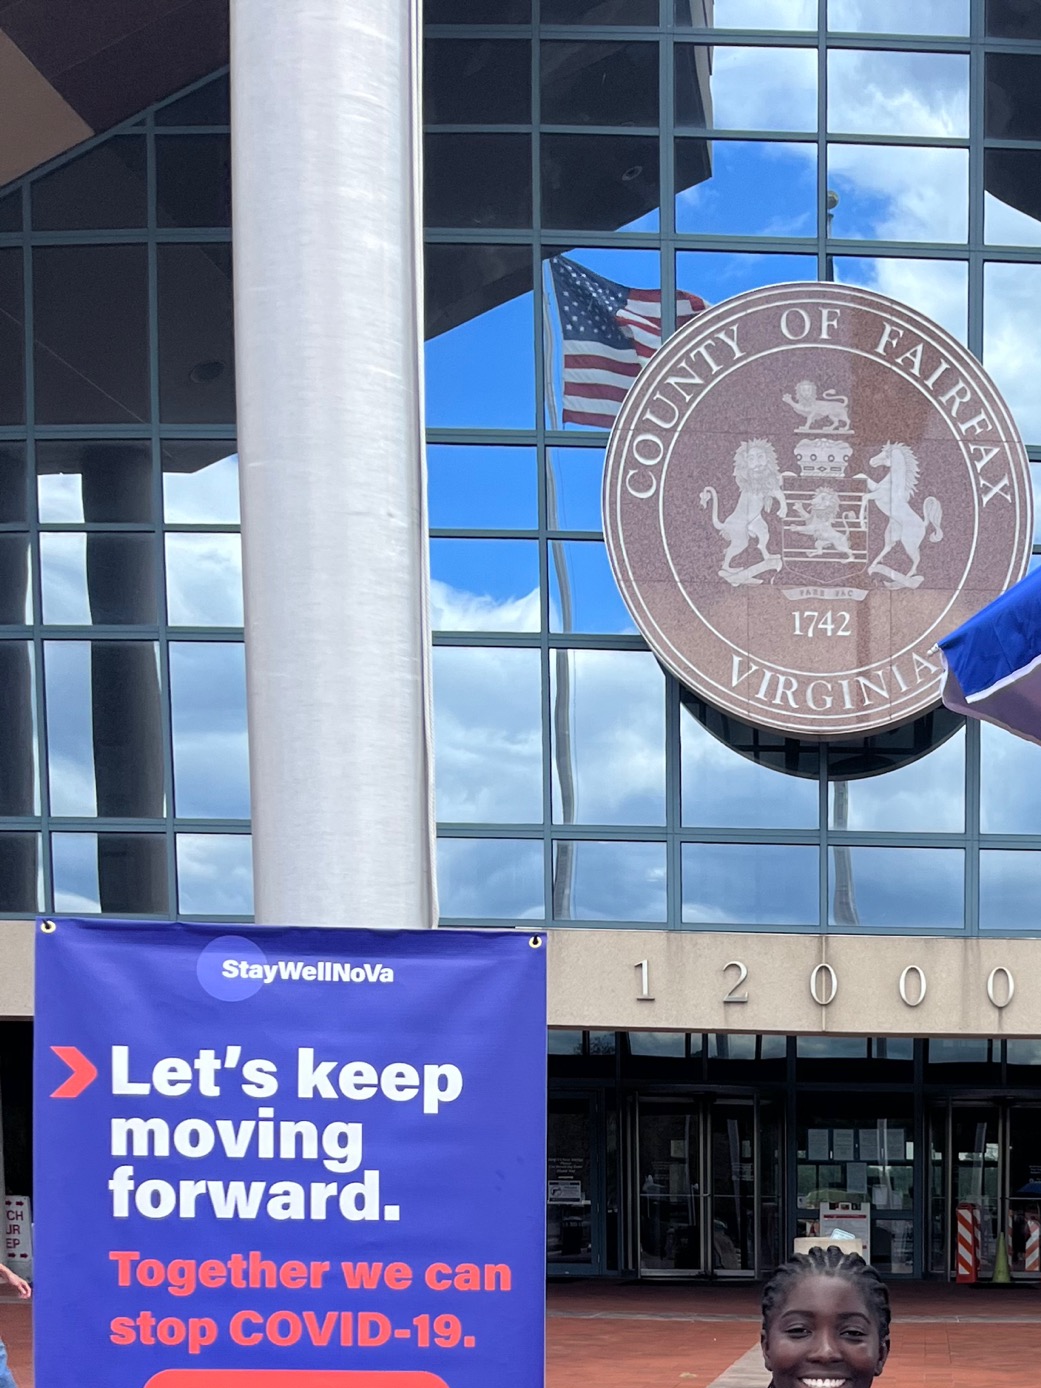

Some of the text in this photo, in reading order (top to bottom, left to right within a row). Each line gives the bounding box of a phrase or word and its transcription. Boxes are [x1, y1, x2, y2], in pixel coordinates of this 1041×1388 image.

[626, 307, 1013, 508] COUNTY OF FAIRFAX
[791, 610, 852, 637] 1742
[730, 650, 940, 711] VIRGINIA
[222, 959, 395, 983] StayWellNoVa
[111, 1045, 463, 1114] Let’s keep
[111, 1107, 364, 1173] moving
[108, 1166, 401, 1221] forward.
[109, 1251, 512, 1296] Together we can
[109, 1311, 476, 1354] stop COVID-19.
